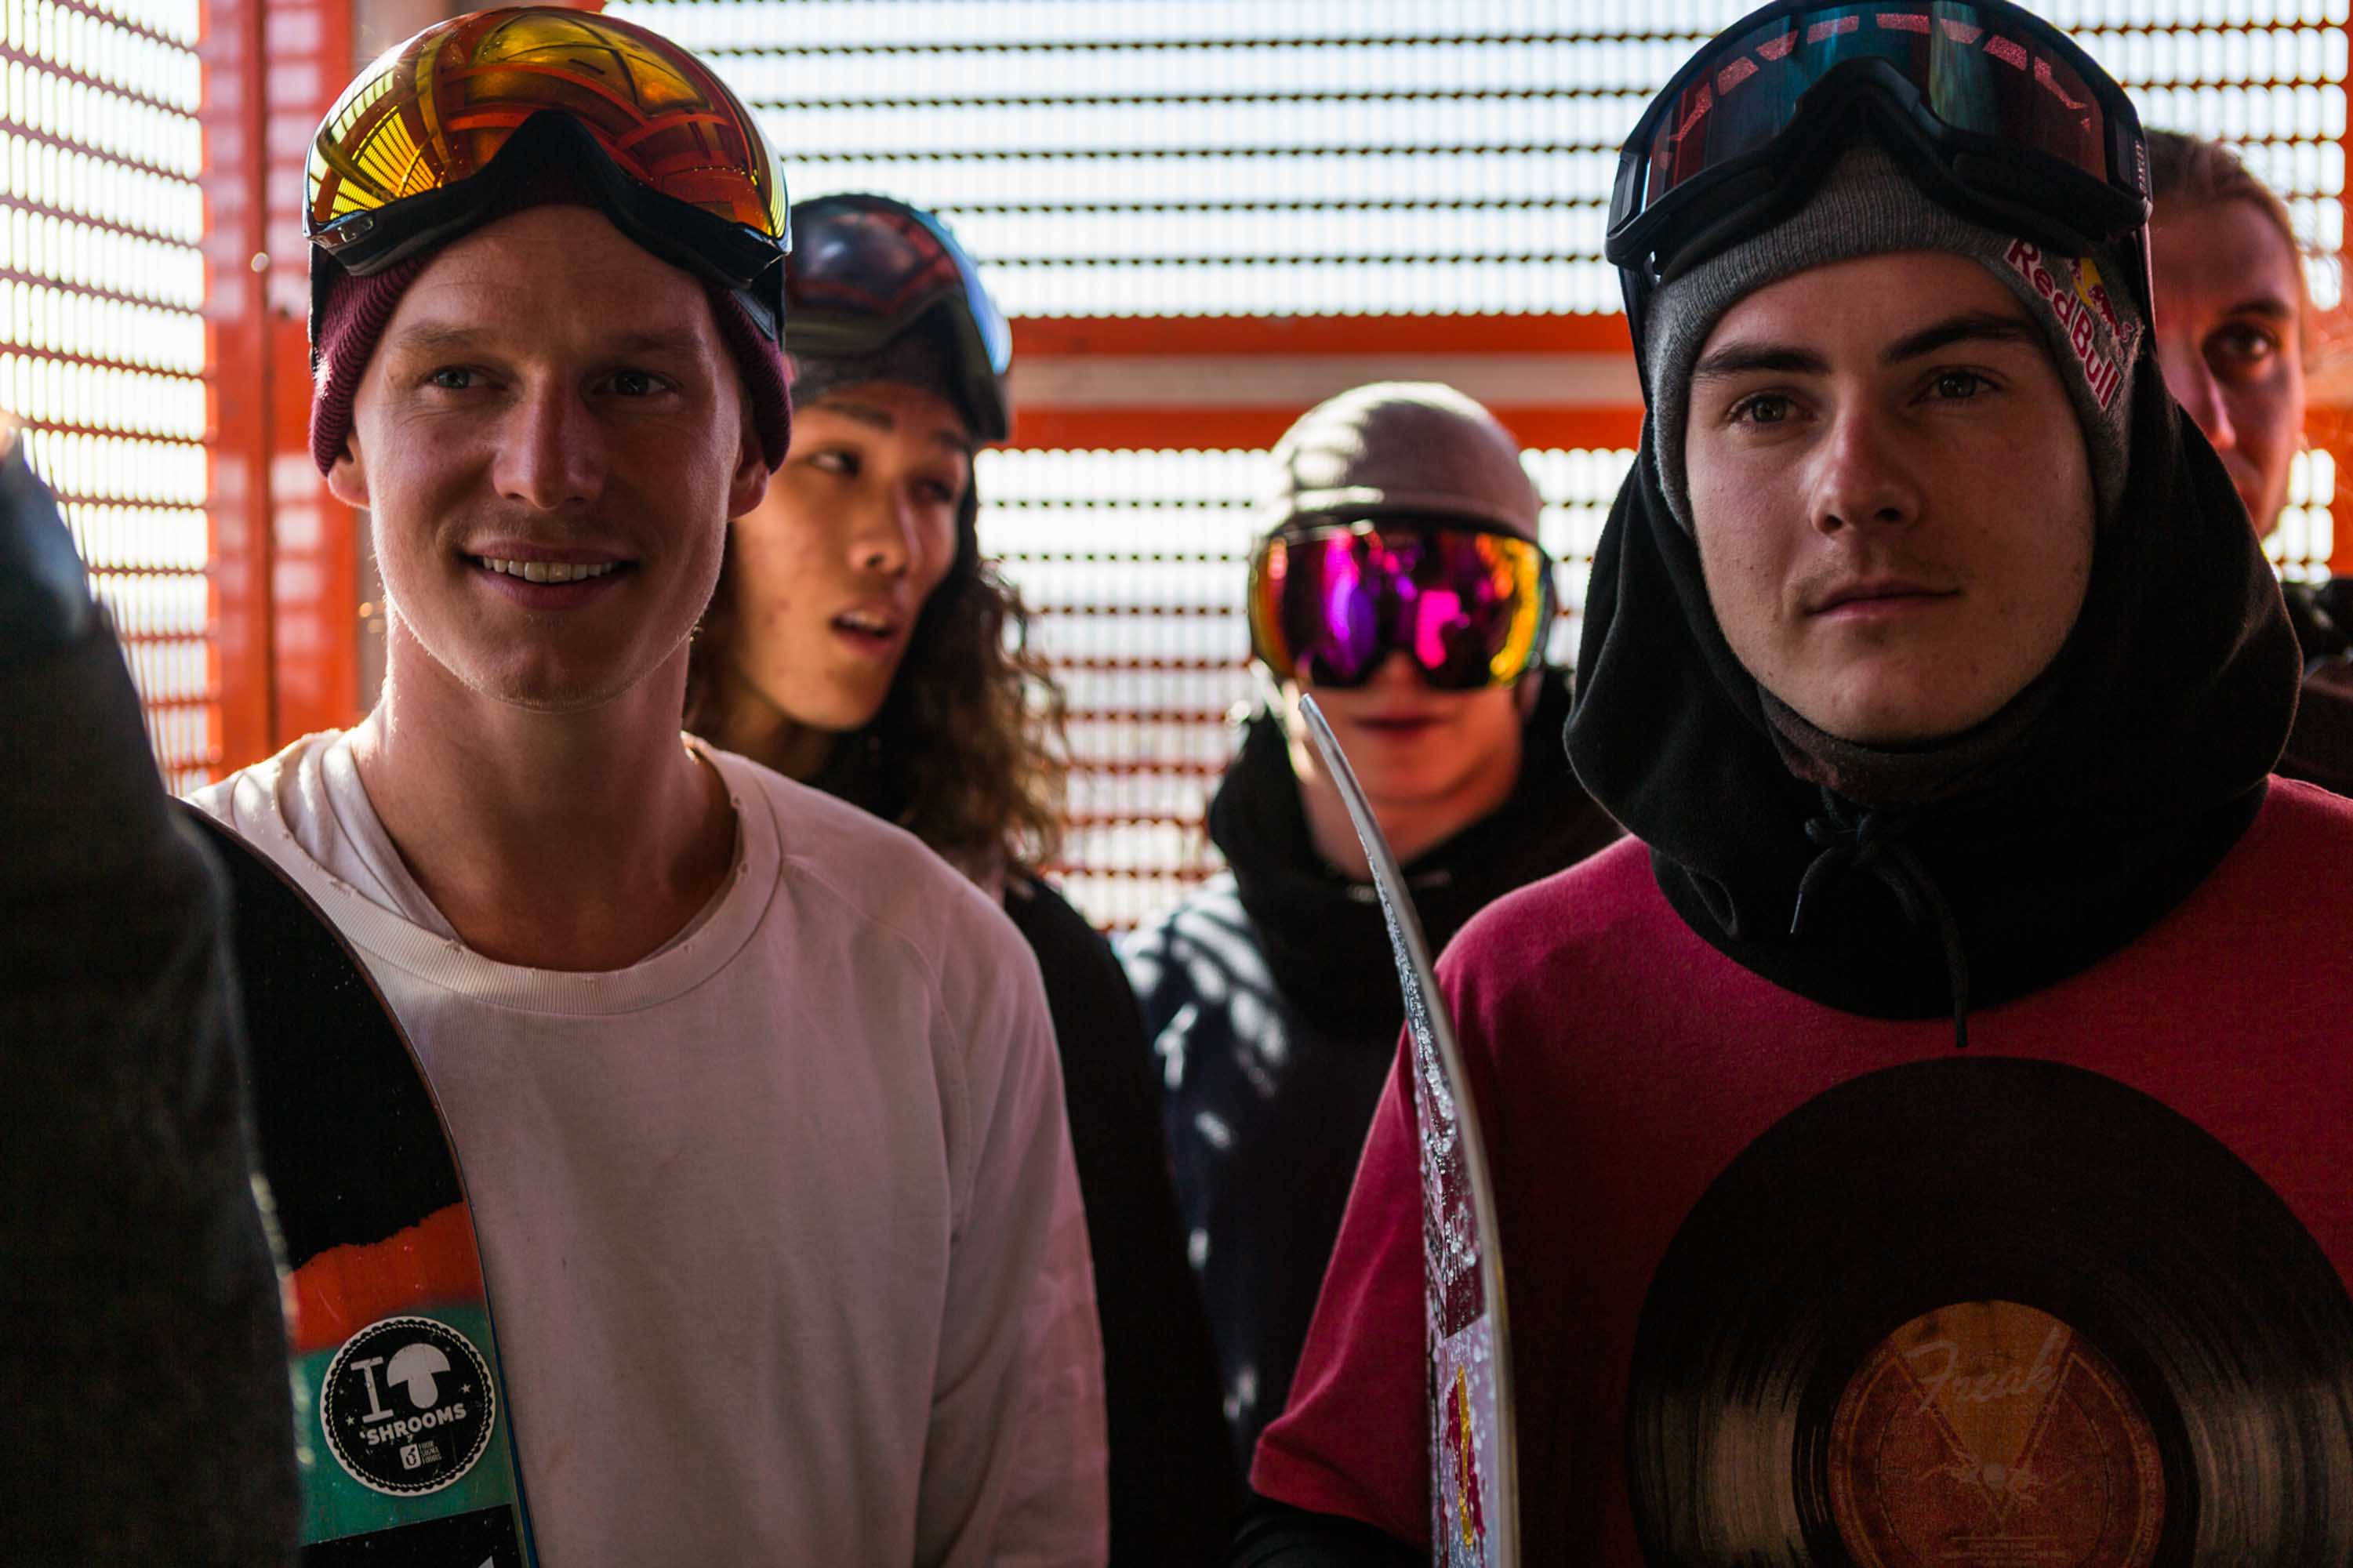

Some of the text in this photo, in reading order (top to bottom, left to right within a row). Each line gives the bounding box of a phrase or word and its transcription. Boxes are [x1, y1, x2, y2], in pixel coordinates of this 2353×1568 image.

[2004, 238, 2120, 410] Red Bull
[350, 1356, 393, 1424] I
